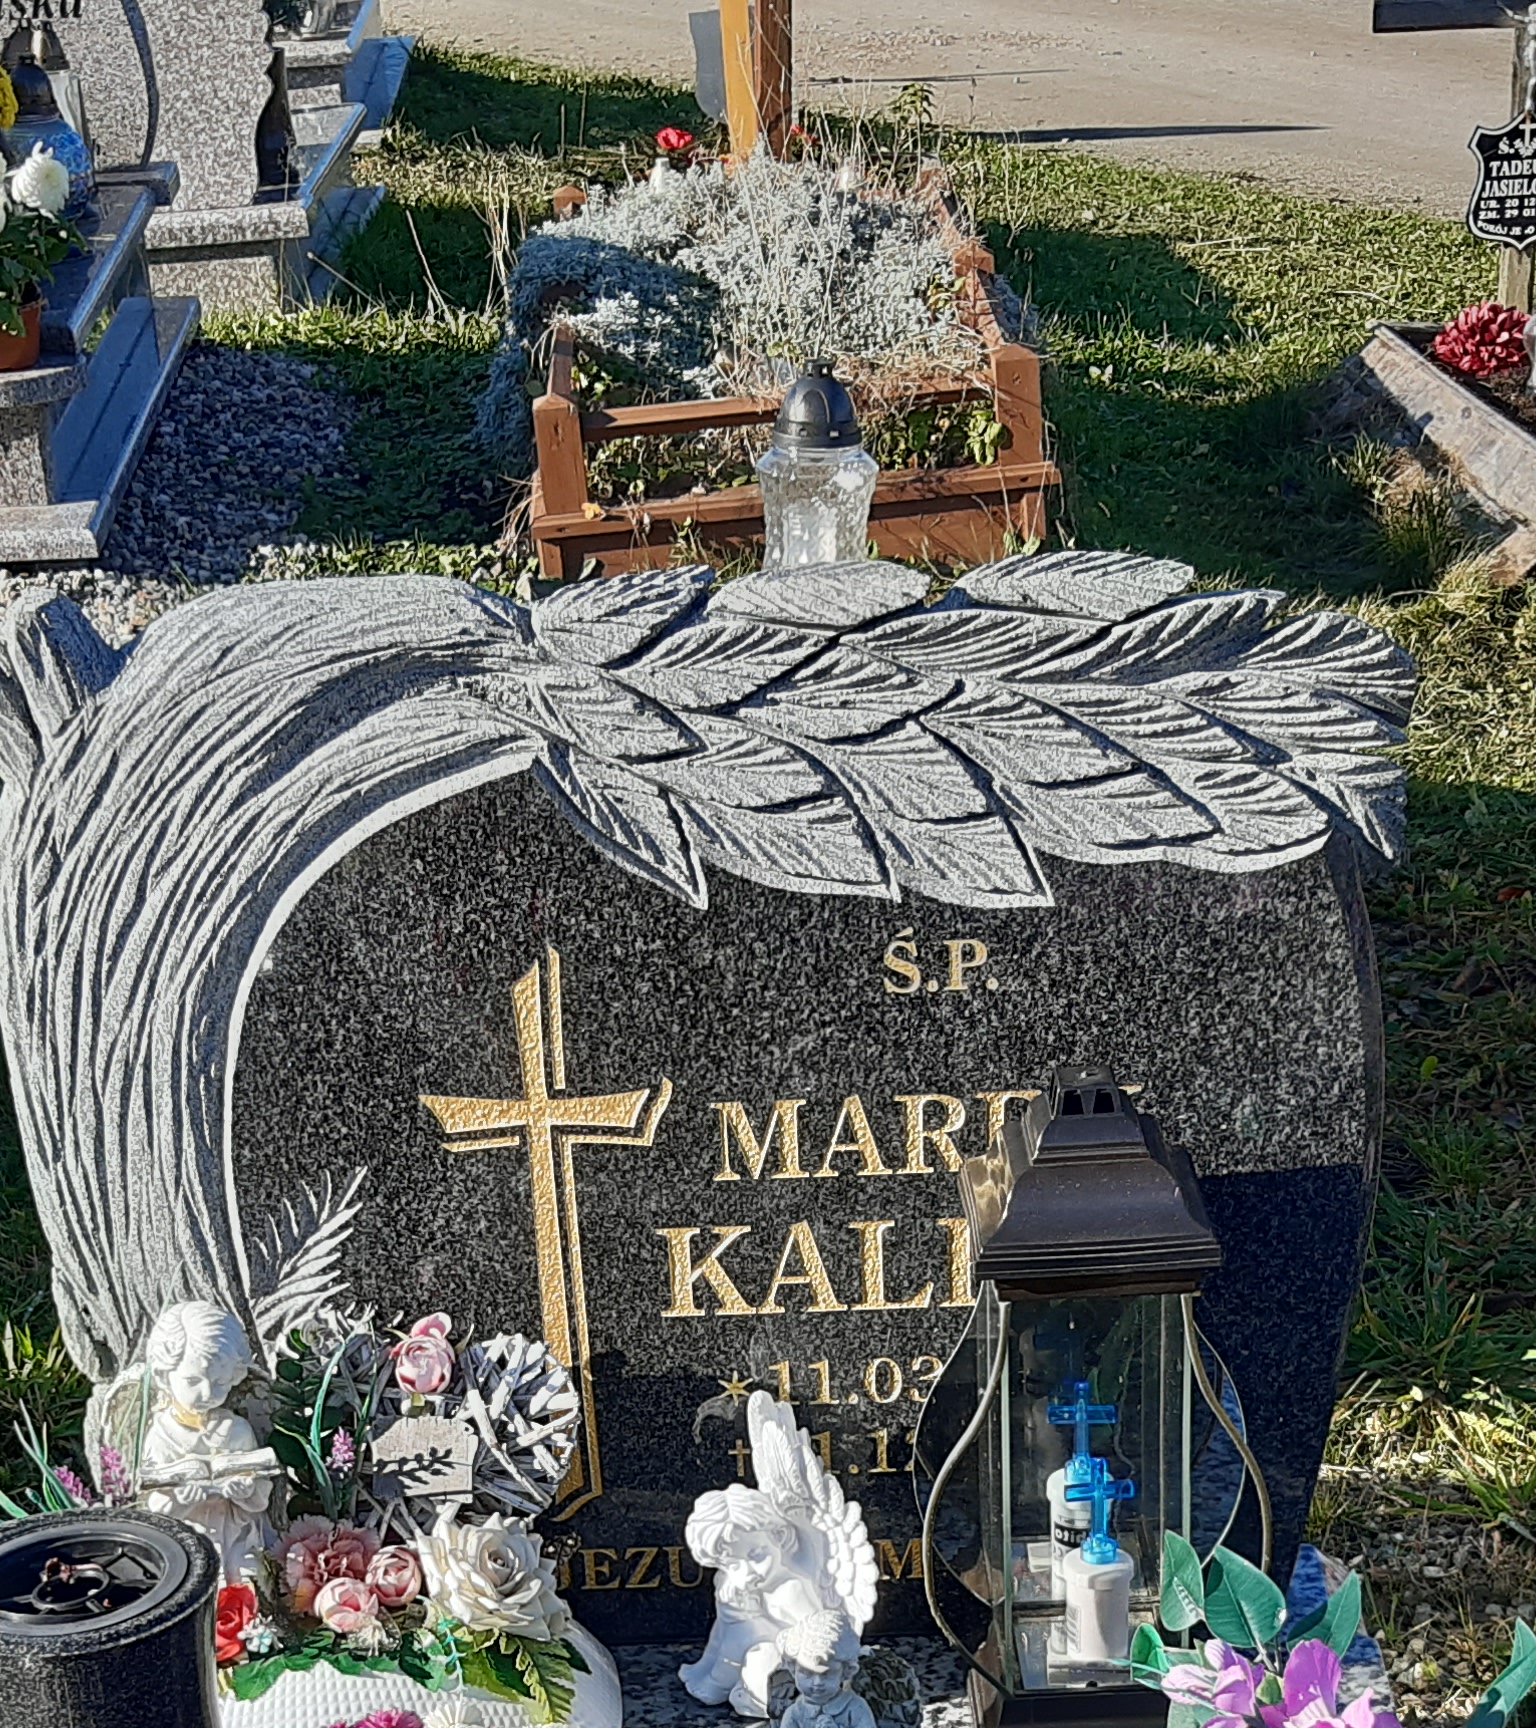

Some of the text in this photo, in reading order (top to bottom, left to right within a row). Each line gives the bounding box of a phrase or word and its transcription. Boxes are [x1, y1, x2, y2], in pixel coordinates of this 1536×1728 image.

[1479, 199, 1501, 209] UR.
[1504, 199, 1520, 208] 20
[1524, 197, 1536, 207] 12
[1478, 210, 1501, 220] ZM.
[1504, 209, 1519, 219] 29
[1522, 208, 1536, 217] 01
[1477, 220, 1508, 235] POKÓJ
[882, 926, 1000, 995] Ś.P.
